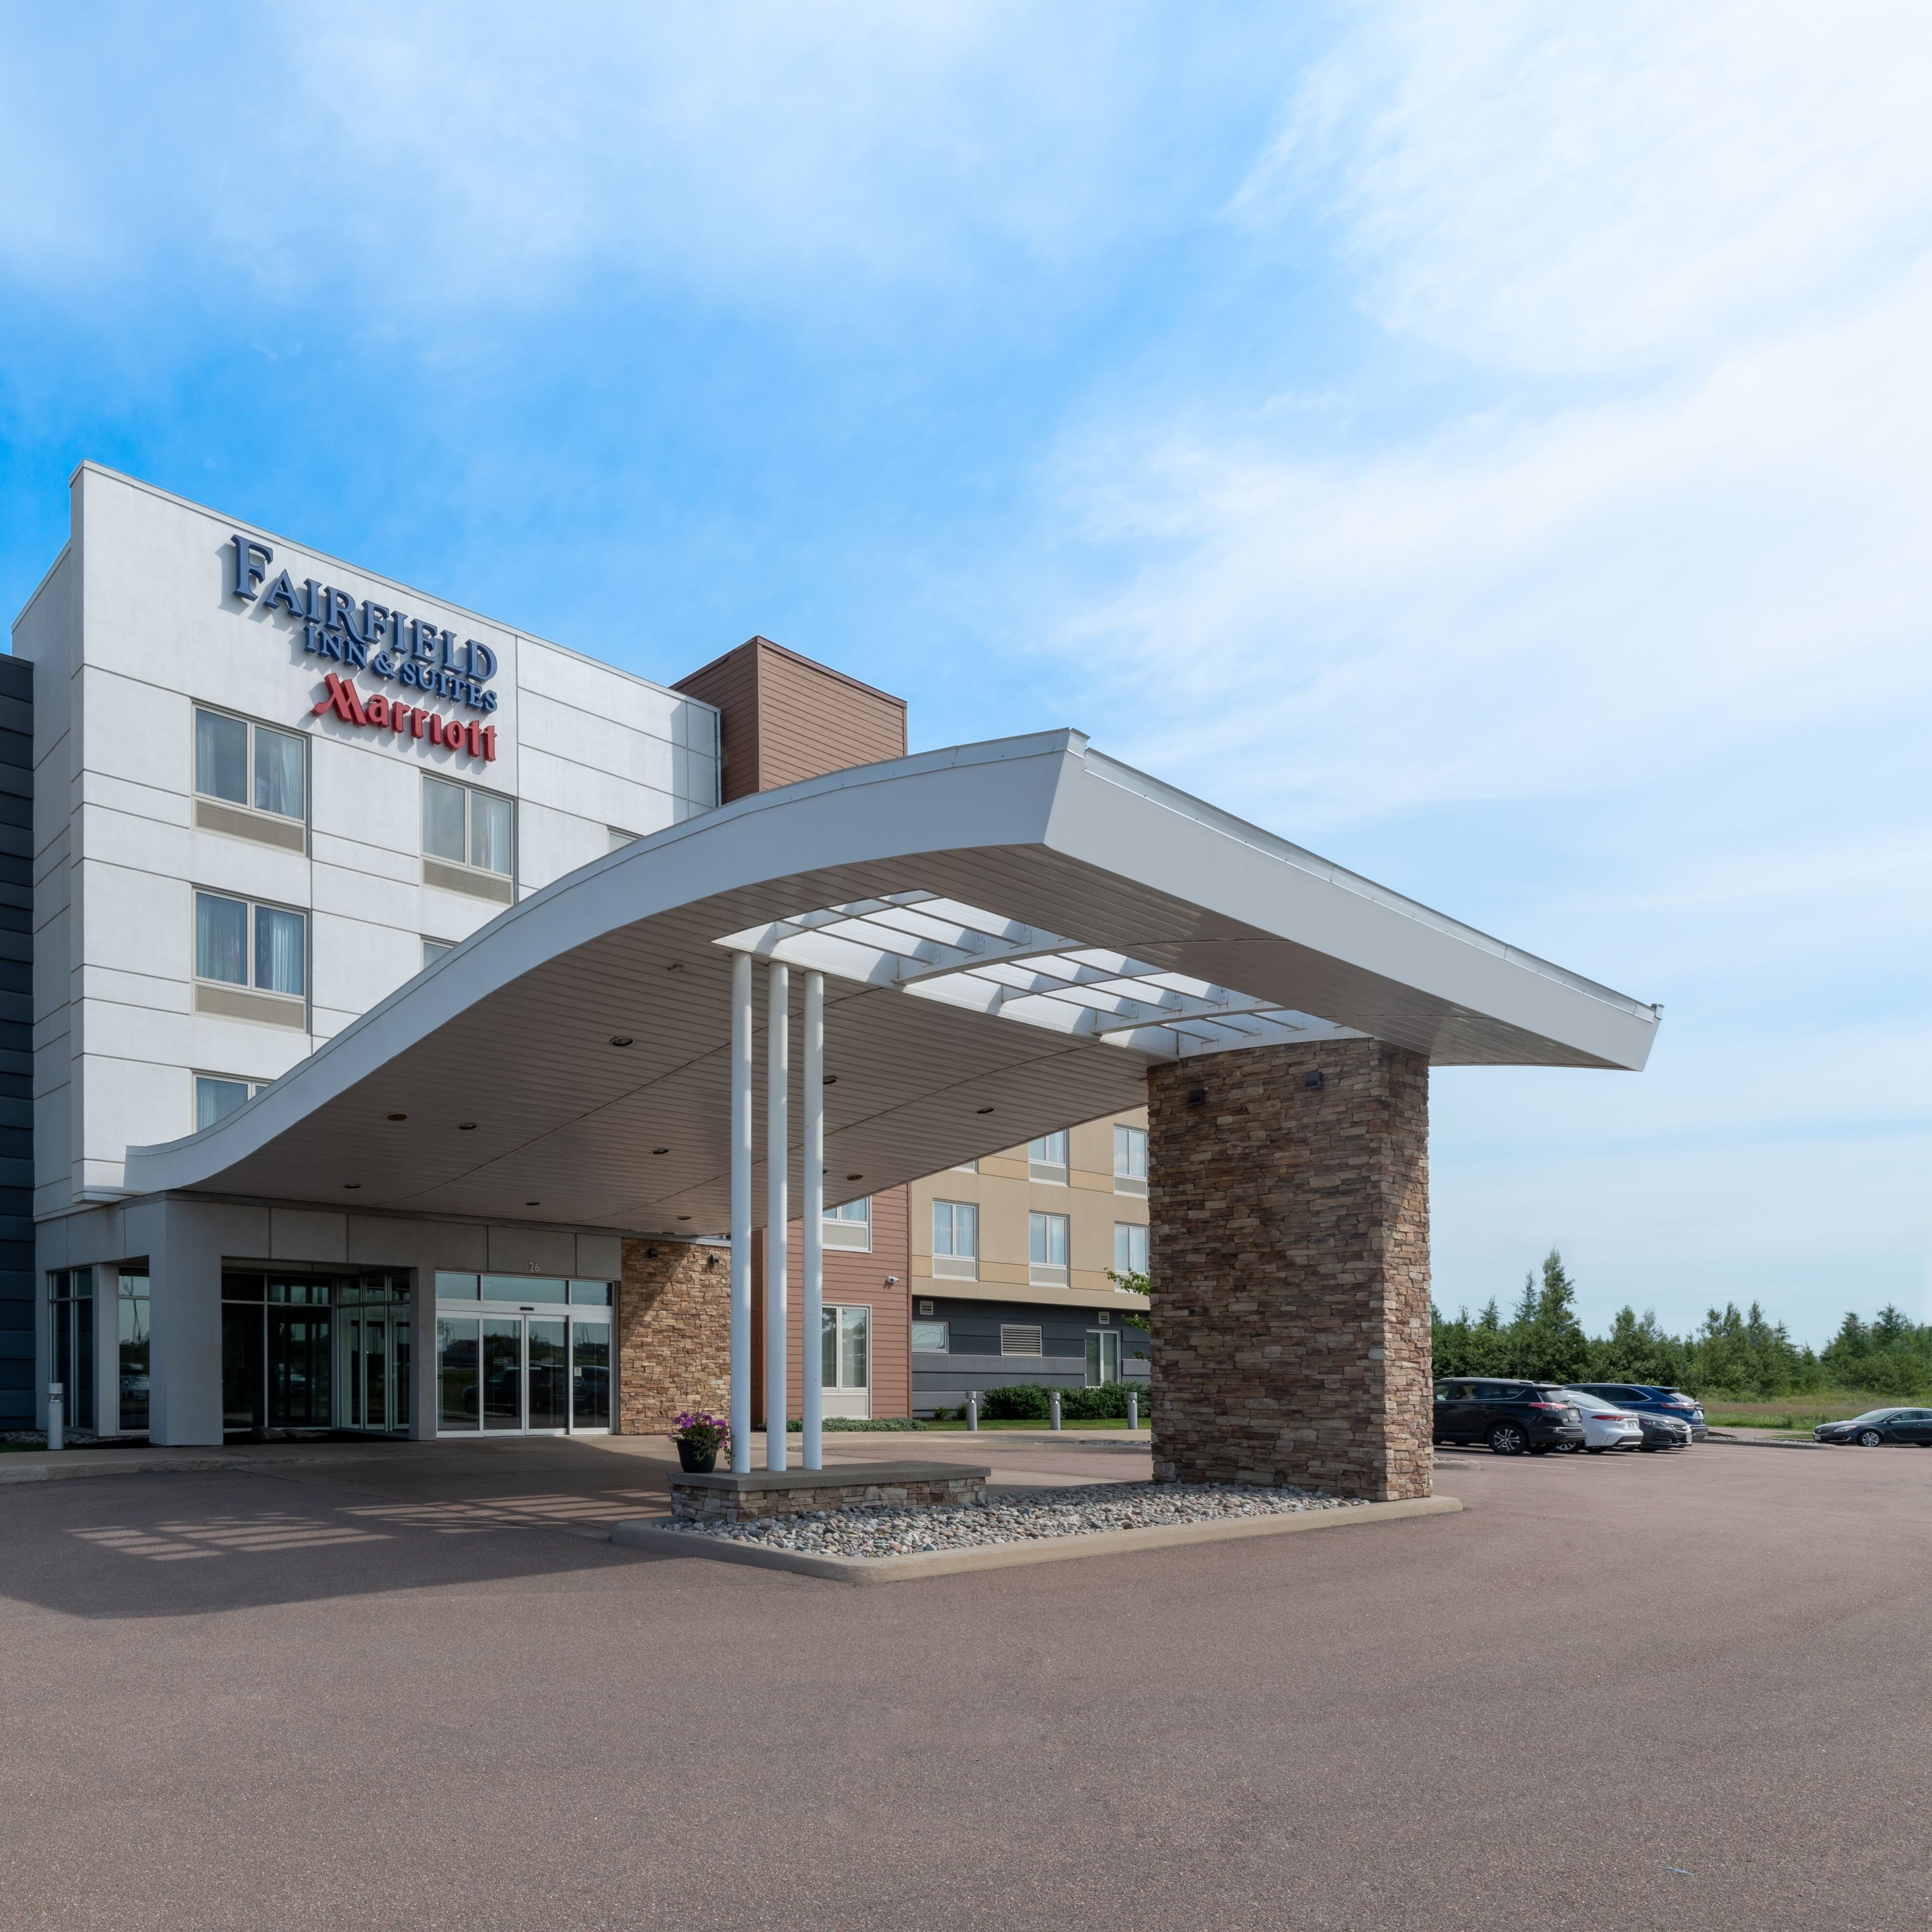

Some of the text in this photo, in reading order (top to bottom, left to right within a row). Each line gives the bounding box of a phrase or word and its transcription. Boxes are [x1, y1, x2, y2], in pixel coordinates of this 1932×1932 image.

[230, 534, 498, 684] FAIRFIELD
[303, 625, 498, 714] INN & SUITES
[310, 672, 498, 763] Marriott
[529, 1262, 540, 1272] 26
